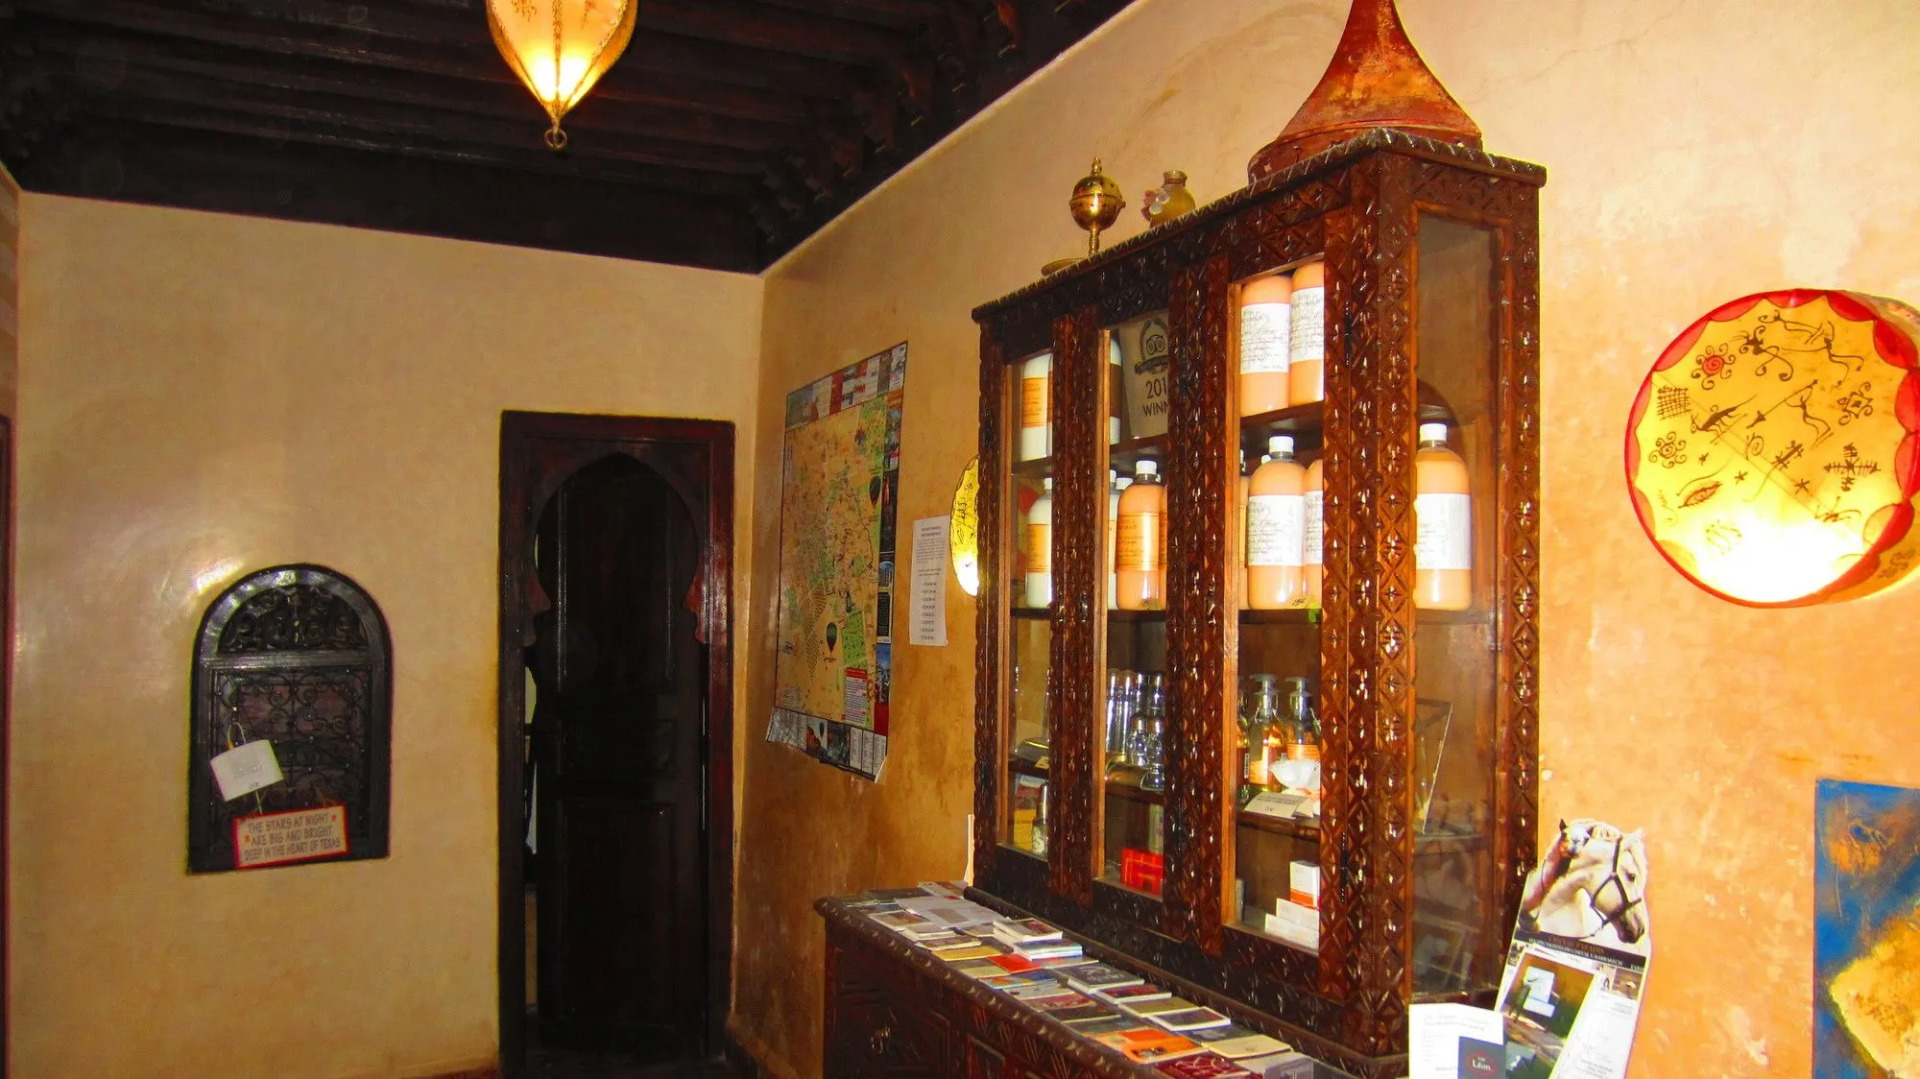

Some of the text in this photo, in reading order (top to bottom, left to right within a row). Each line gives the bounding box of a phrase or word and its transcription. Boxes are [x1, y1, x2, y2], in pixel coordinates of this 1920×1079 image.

[1145, 377, 1167, 400] 201
[1142, 400, 1168, 417] WINN
[249, 812, 329, 834] THE STARS AT NIGHT
[251, 825, 333, 847] ARE BIG AND BRIGHT
[244, 837, 341, 861] DEEP IN THE HEART OF TEXAS
